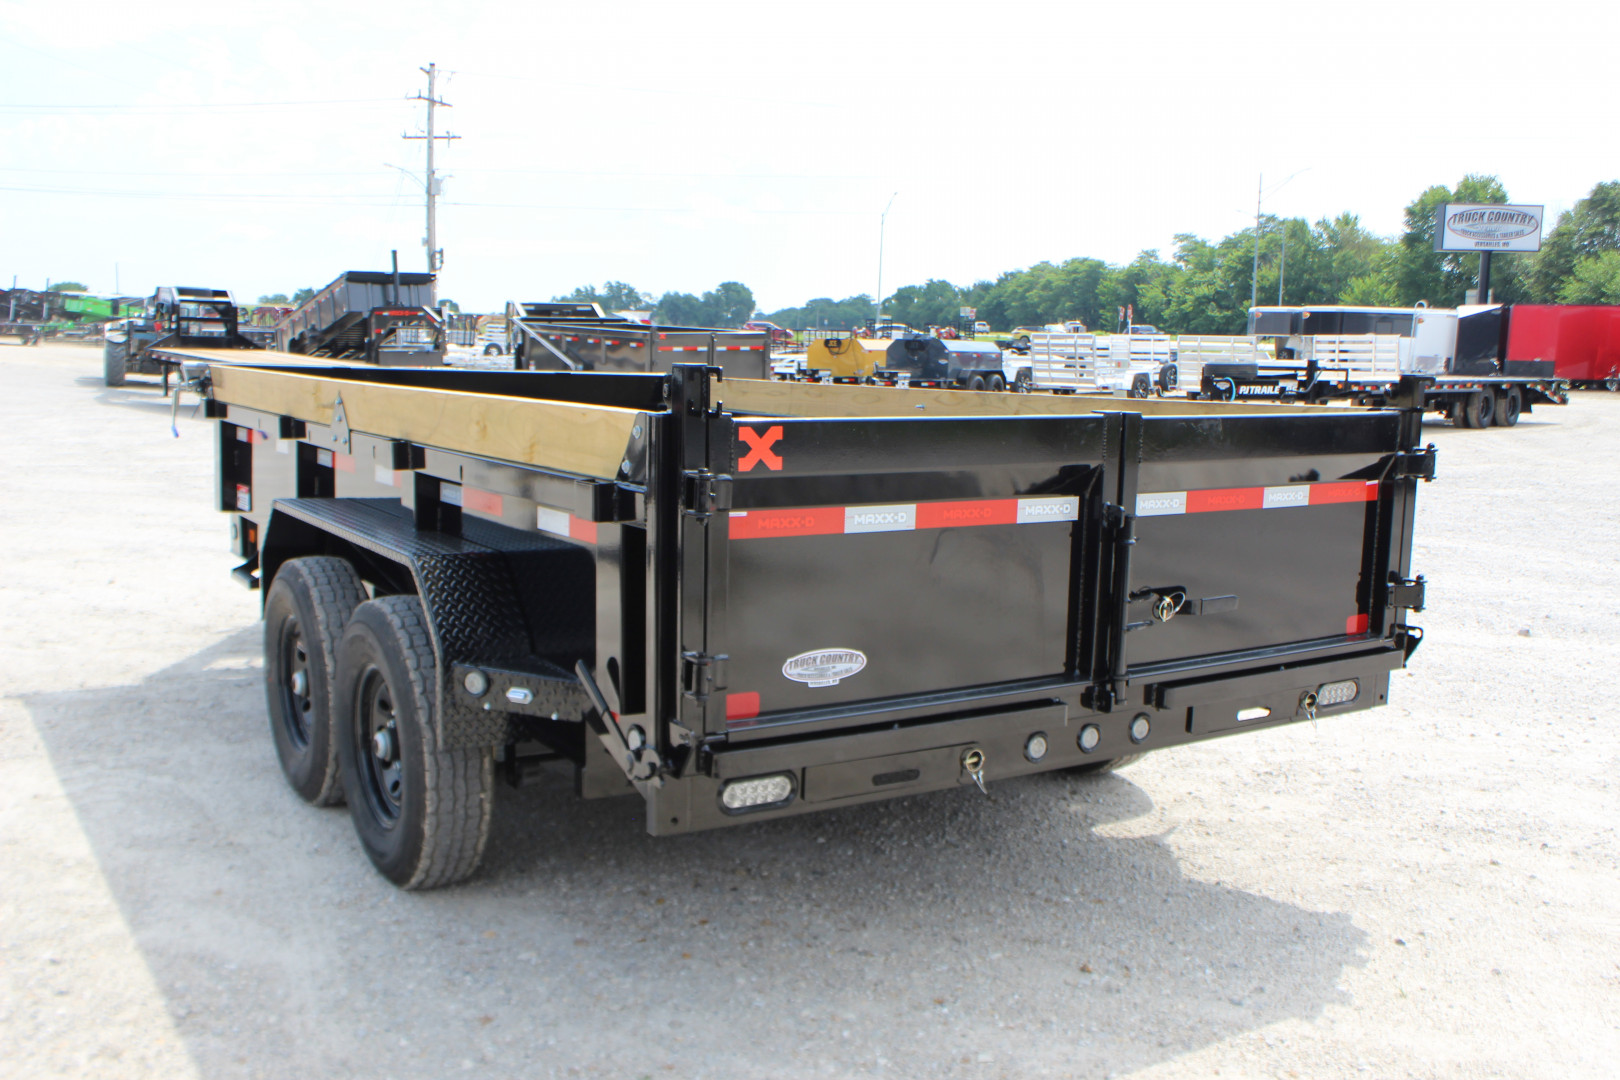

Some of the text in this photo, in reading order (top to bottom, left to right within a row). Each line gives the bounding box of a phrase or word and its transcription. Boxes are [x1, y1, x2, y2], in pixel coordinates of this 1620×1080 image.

[1452, 211, 1534, 225] TRUCK COUNTRY
[789, 653, 860, 671] TRUCK COUNTRY
